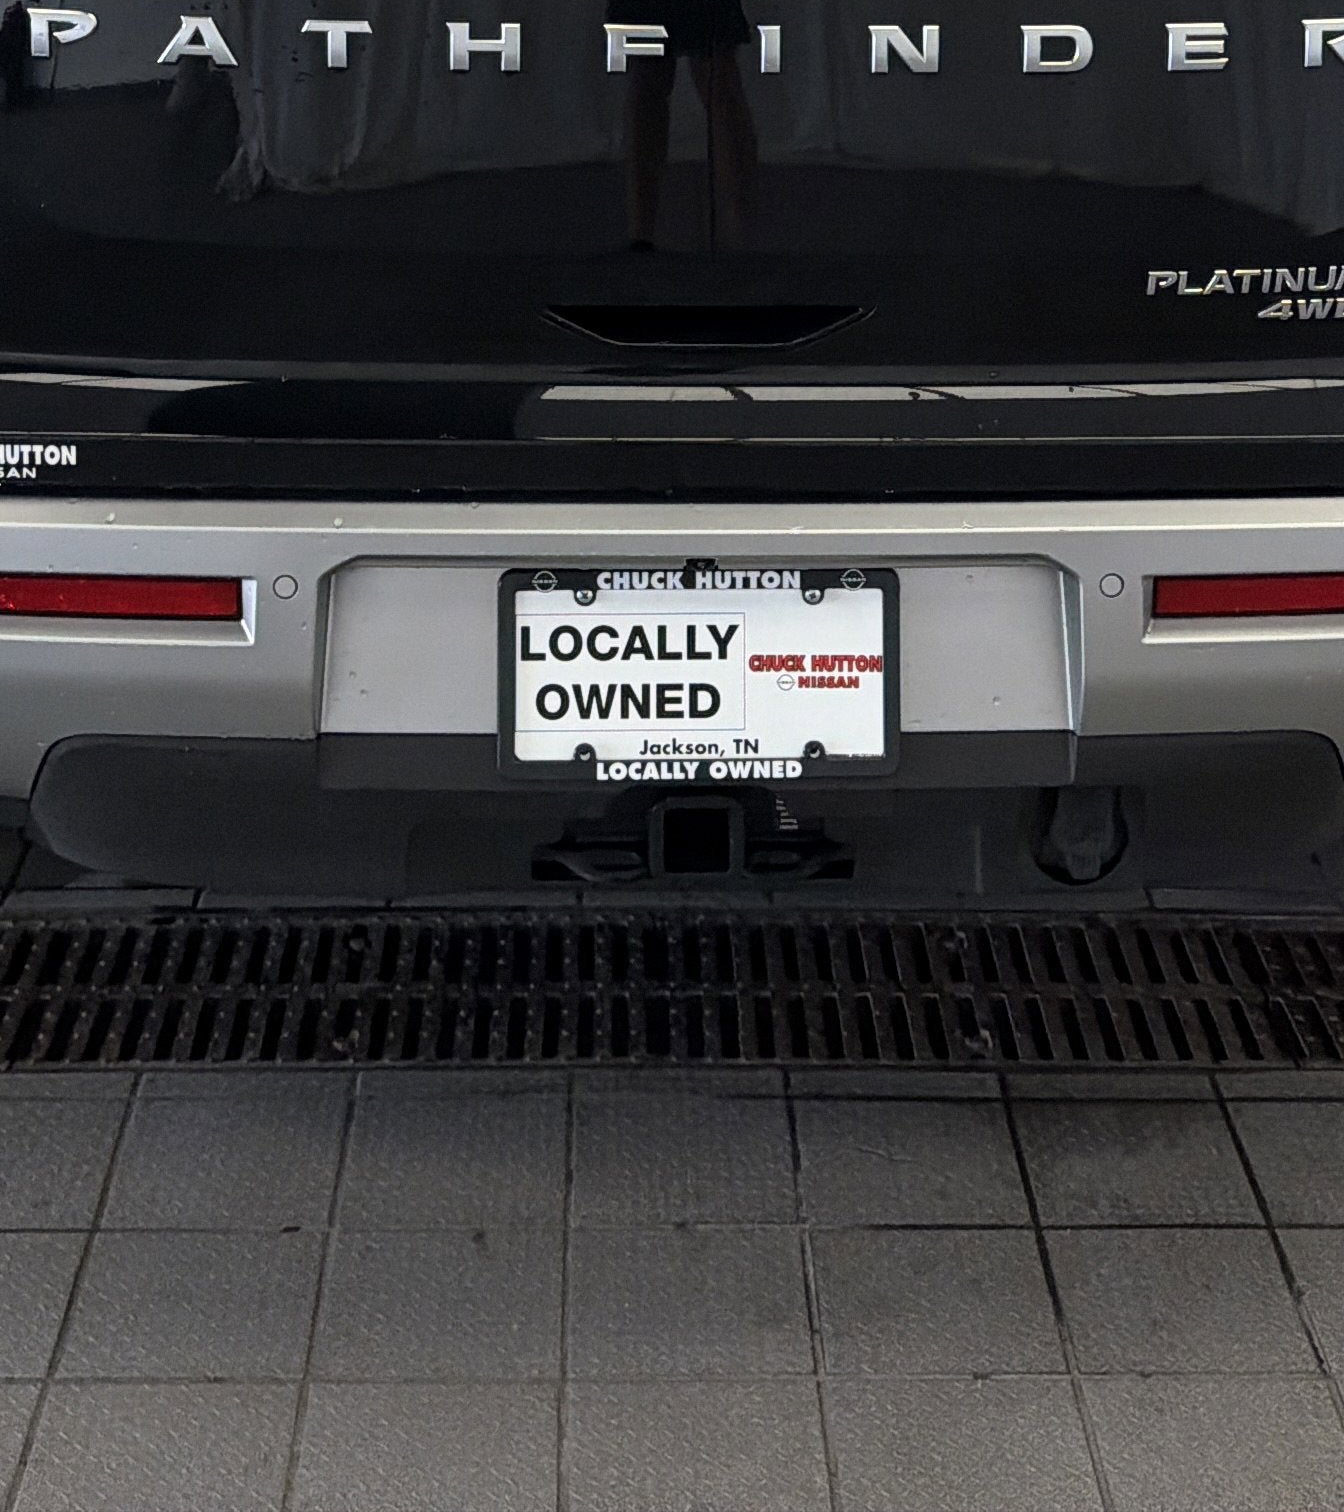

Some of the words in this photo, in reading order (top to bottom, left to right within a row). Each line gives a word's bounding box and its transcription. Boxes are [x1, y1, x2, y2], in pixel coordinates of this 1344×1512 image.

[596, 572, 684, 589] CHUCK
[695, 571, 801, 589] HUTTON
[520, 624, 740, 661] LOCALLY
[748, 654, 806, 673] CHUCK
[811, 654, 883, 673] HUTTON
[798, 675, 860, 689] NISSAN
[535, 684, 721, 720] OWNED
[639, 739, 726, 756] Jackson,
[732, 739, 759, 755] TN
[596, 762, 700, 781] LOCALLY
[709, 761, 803, 779] OWNED
